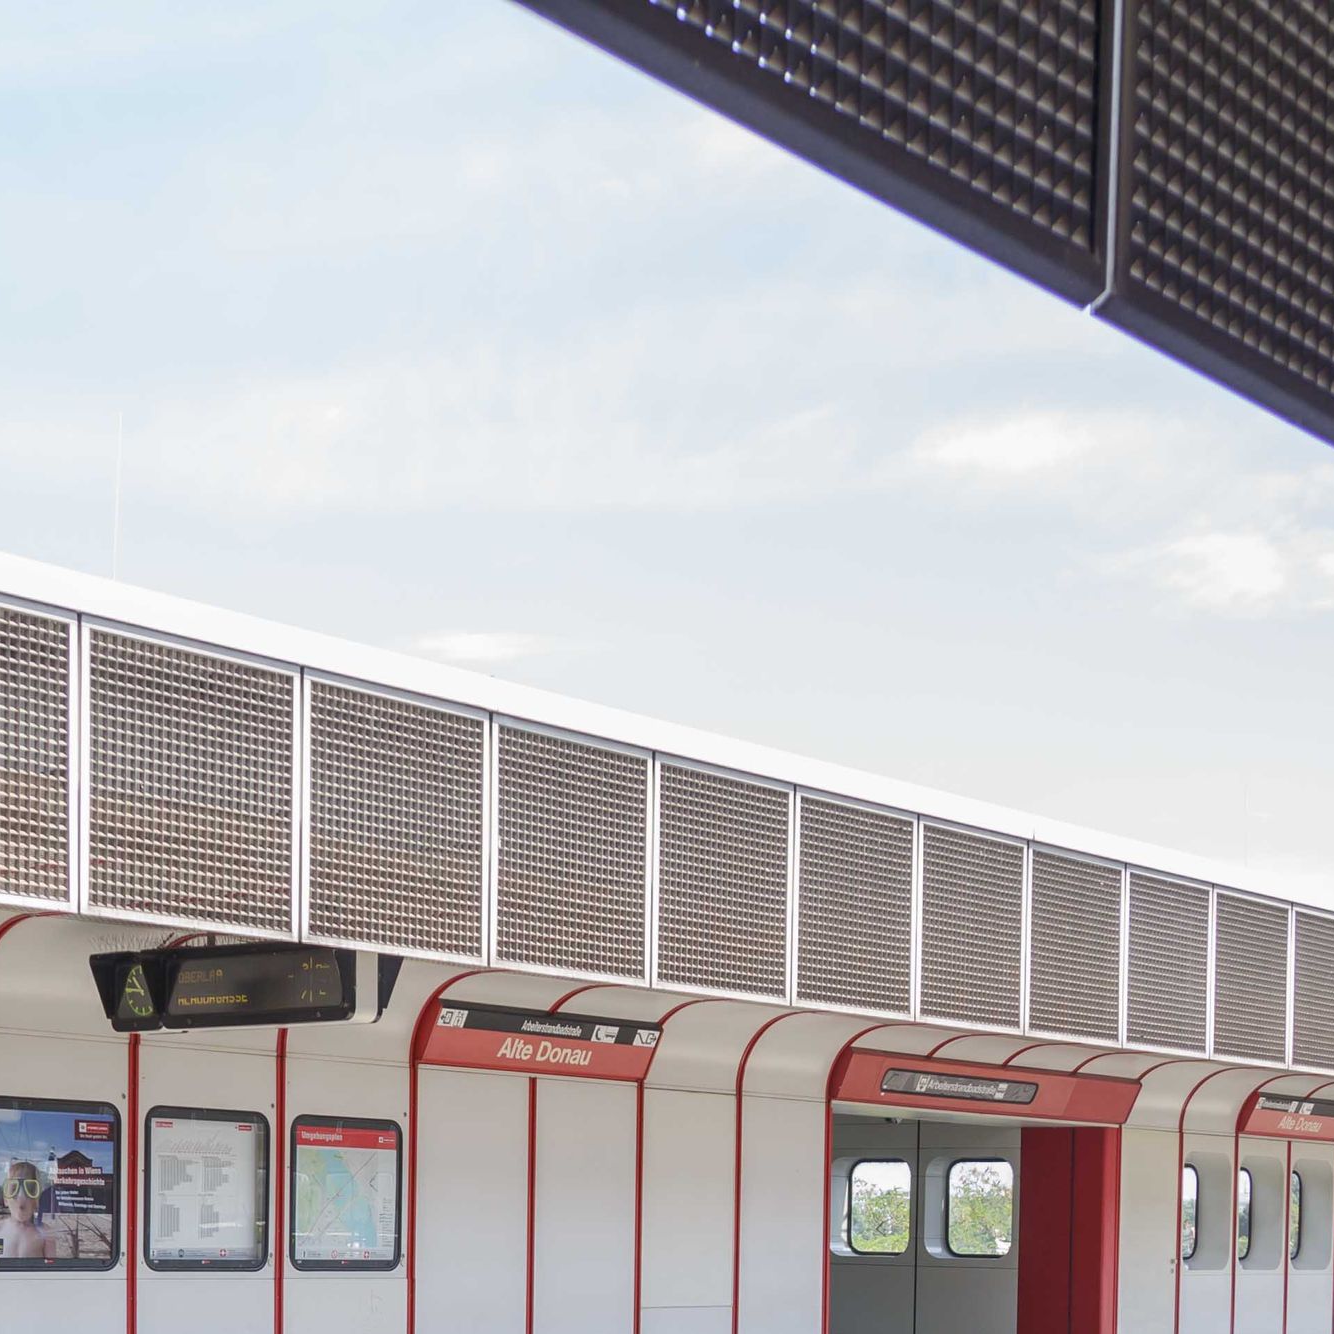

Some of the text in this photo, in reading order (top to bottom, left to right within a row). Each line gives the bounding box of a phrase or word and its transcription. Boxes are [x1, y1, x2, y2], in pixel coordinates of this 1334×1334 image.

[521, 1019, 583, 1037] Arbeiterstrandbadstraße
[497, 1037, 592, 1066] Alte Donau
[1277, 1115, 1322, 1132] Alte Donau
